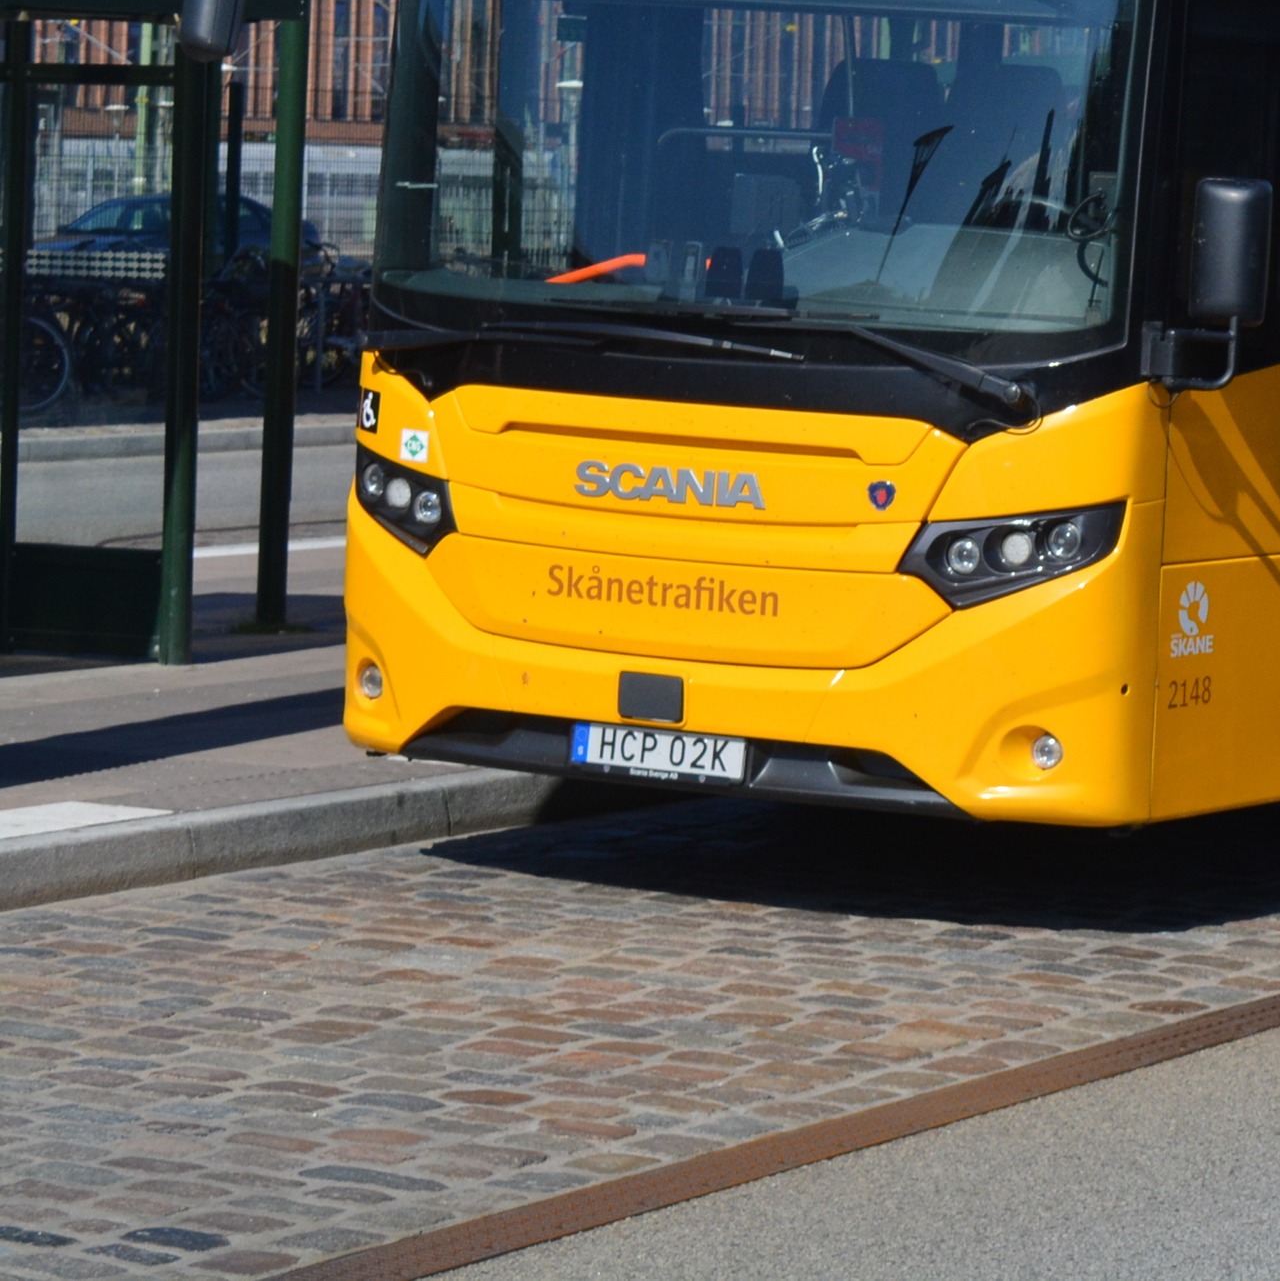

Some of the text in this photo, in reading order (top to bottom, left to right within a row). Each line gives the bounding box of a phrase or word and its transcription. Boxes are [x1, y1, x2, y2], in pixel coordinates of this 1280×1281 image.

[573, 459, 767, 511] SCANIA
[546, 563, 780, 618] Skånetrafiken
[1167, 675, 1212, 710] 2148
[599, 726, 730, 772] HCP 02K
